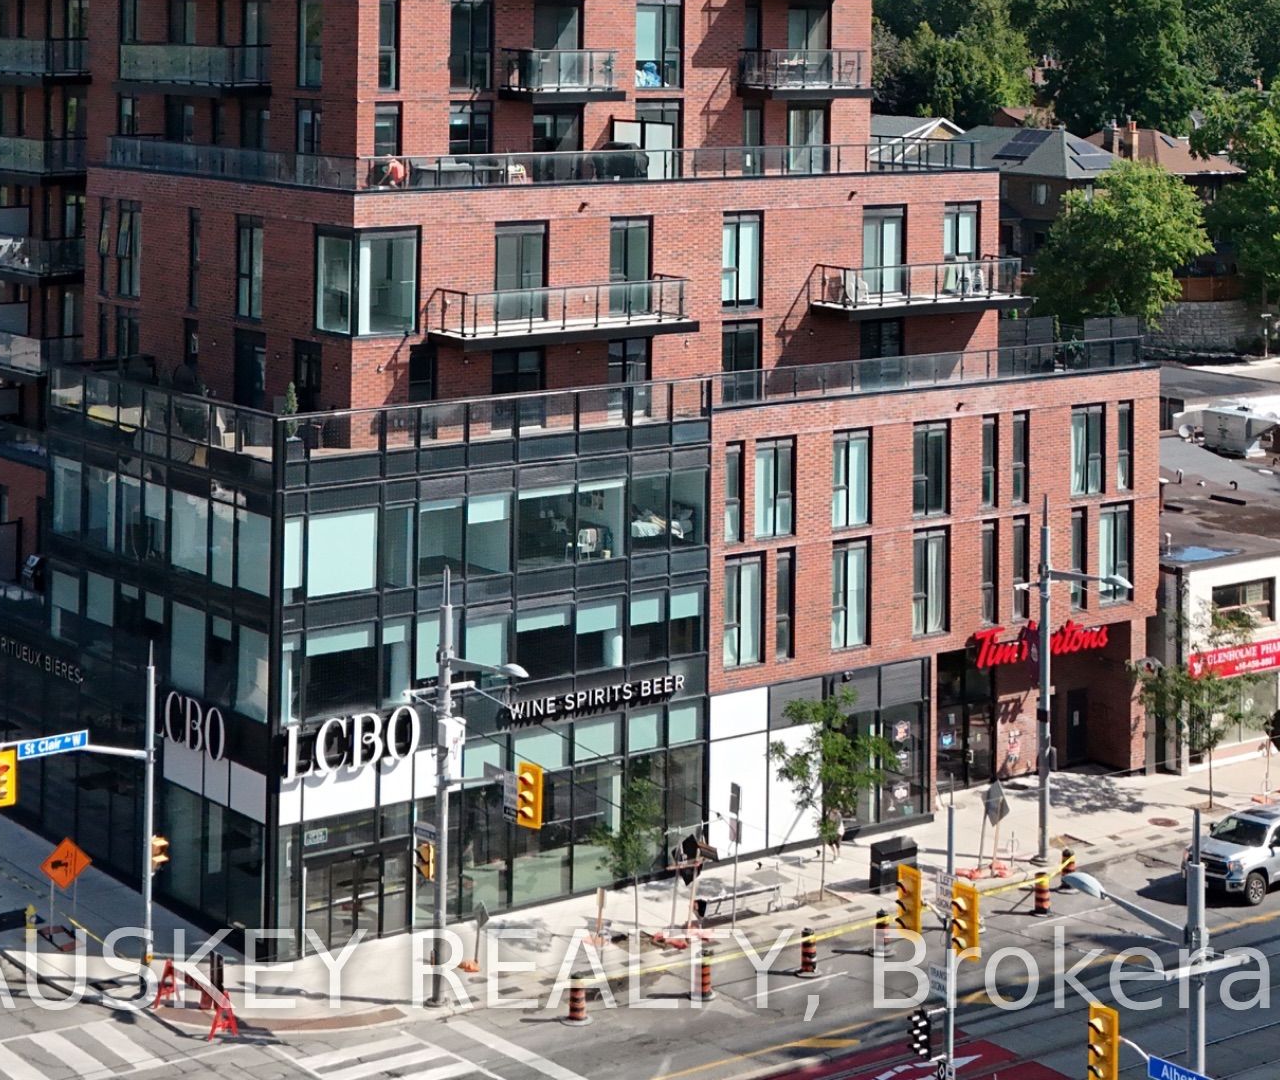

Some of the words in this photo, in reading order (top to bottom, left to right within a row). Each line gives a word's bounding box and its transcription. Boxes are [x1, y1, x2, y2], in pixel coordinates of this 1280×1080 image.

[975, 627, 1019, 668] Tim
[1021, 620, 1108, 662] rtons
[1207, 645, 1258, 666] GLENHOLME
[510, 696, 556, 720] WINE
[564, 683, 632, 710] SPIRITS
[641, 674, 685, 697] BEER
[24, 742, 36, 755] St
[38, 738, 61, 753] Clair
[72, 734, 82, 747] W
[282, 705, 421, 784] LCBO
